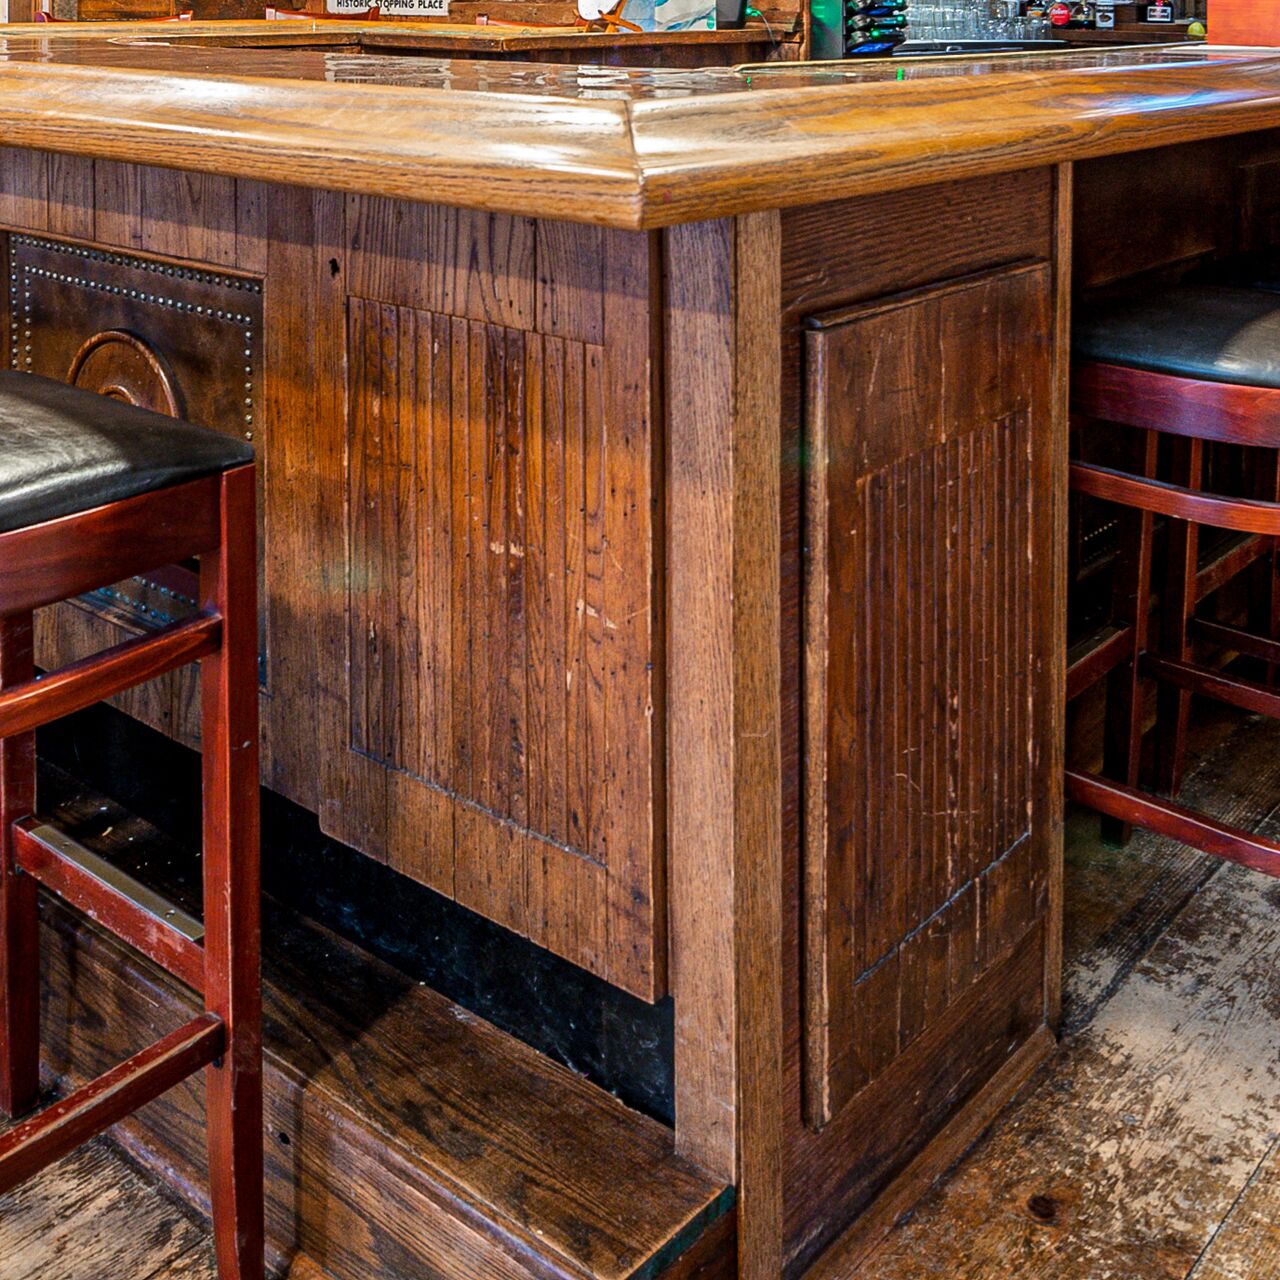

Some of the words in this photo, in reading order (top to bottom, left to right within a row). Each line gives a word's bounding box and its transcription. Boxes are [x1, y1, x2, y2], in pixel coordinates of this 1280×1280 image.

[336, 0, 372, 8] HISTORIC
[375, 0, 415, 9] STOPPING
[417, 0, 444, 10] PLACE
